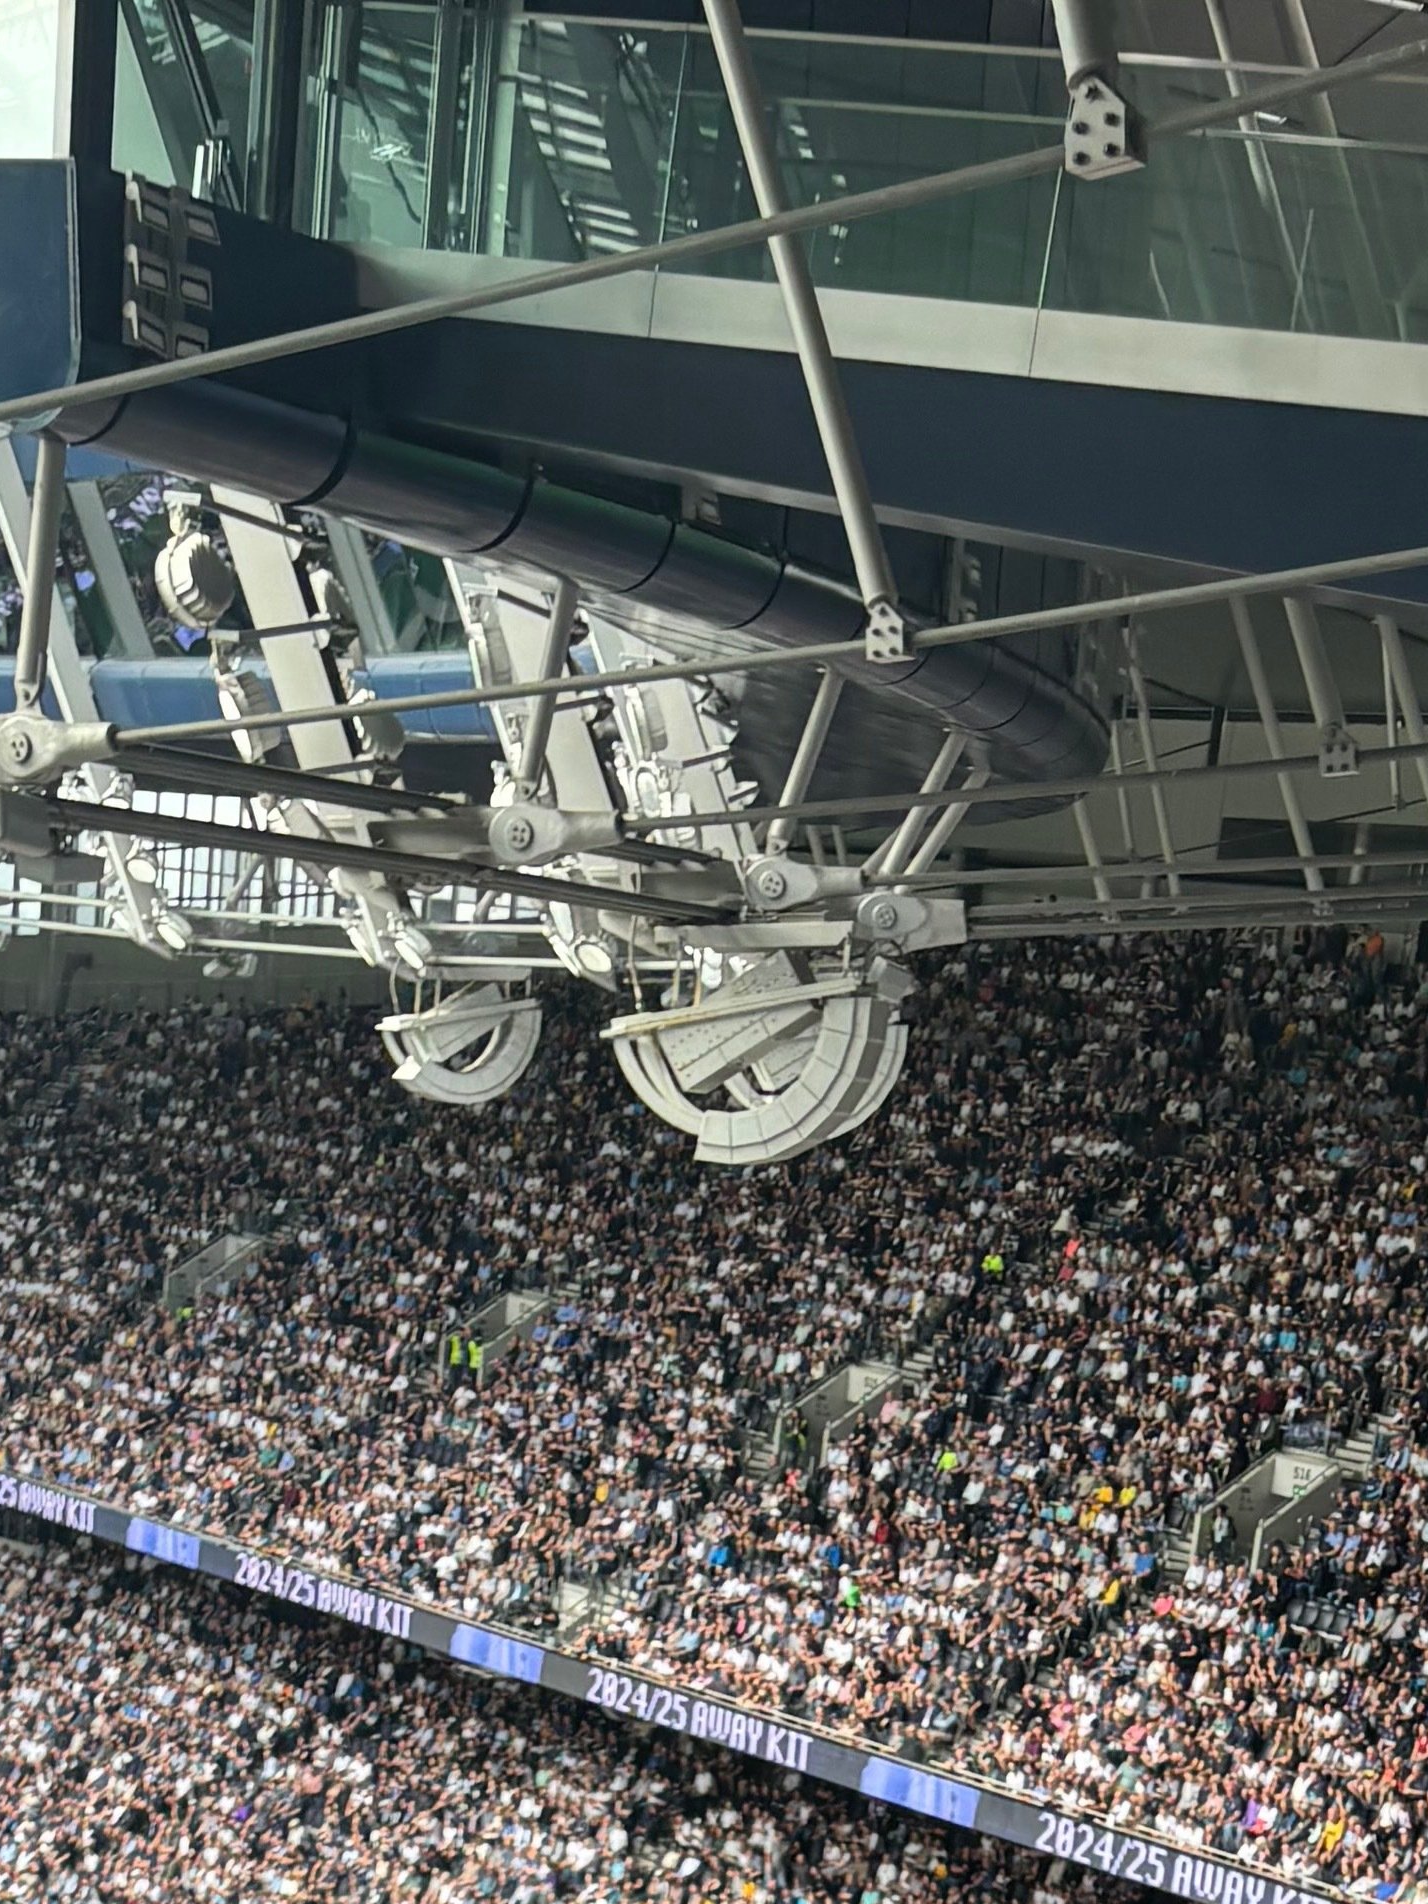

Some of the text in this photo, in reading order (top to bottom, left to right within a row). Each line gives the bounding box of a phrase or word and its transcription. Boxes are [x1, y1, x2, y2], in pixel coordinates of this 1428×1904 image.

[18, 1482, 66, 1523] AWAY
[66, 1498, 97, 1534] KIT
[234, 1553, 414, 1639] 2024/25 AWAY KIT
[586, 1667, 813, 1772] 2024/25 AWAY KIT
[1035, 1811, 1168, 1888] 2024/25
